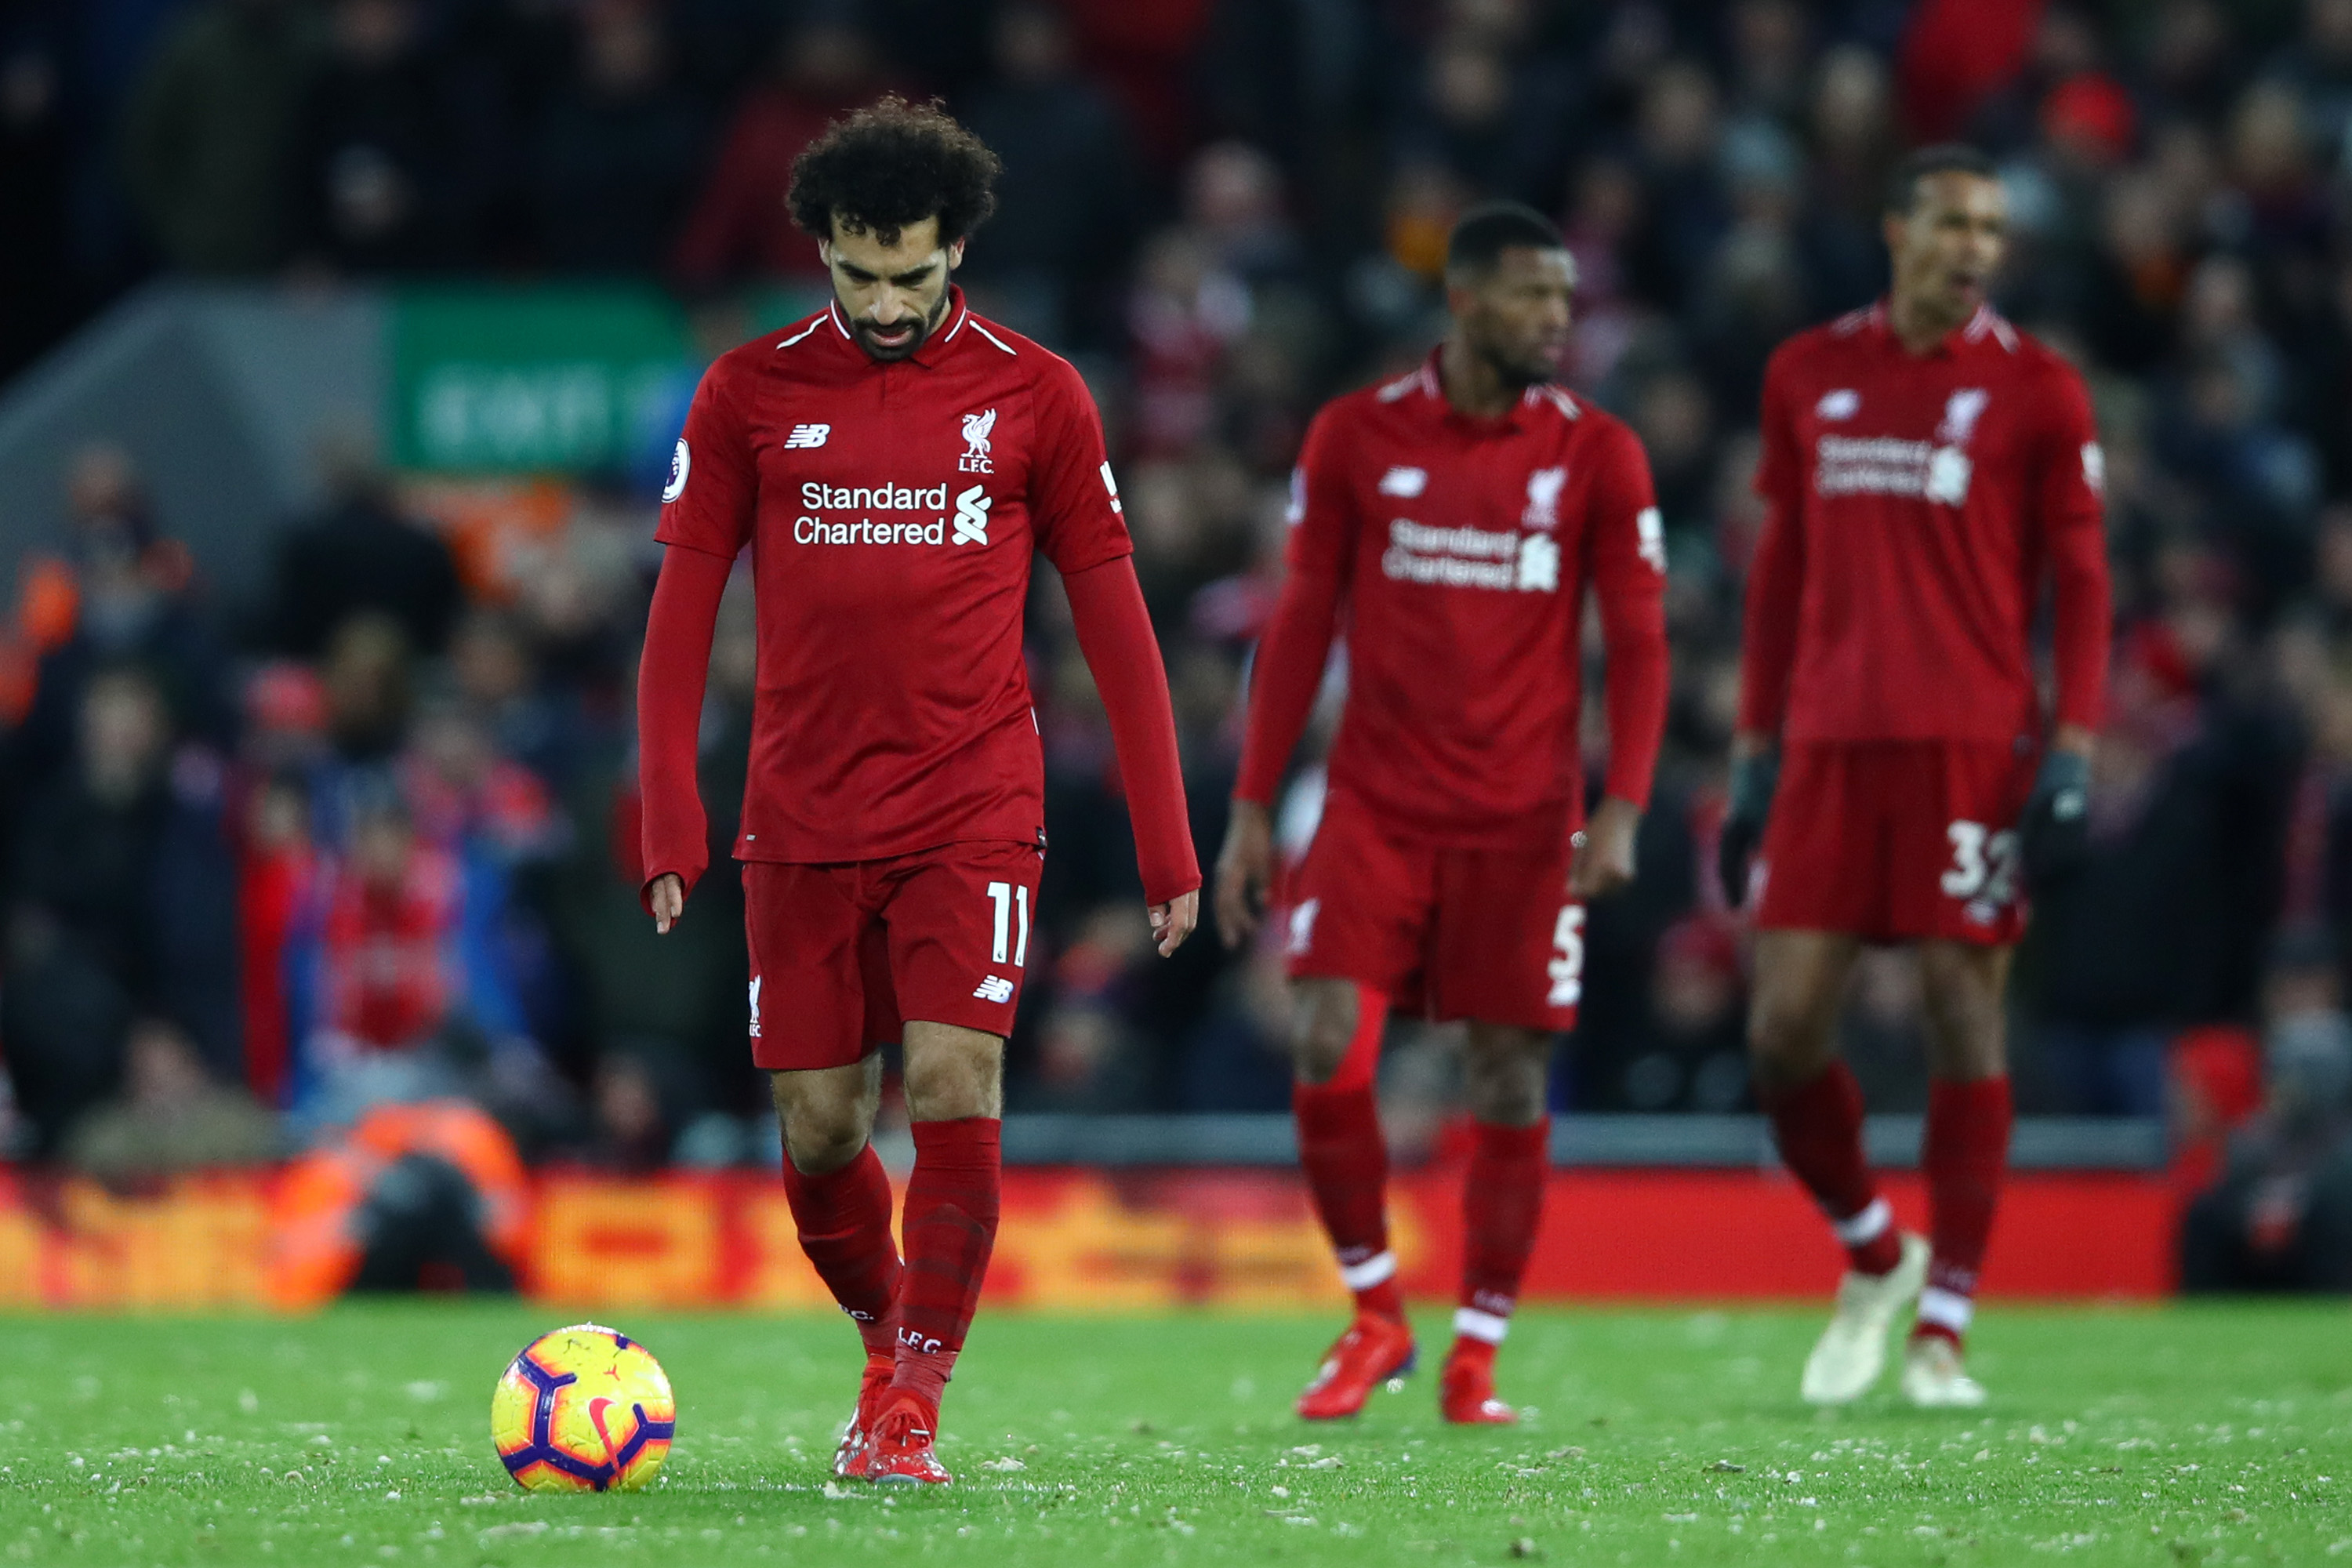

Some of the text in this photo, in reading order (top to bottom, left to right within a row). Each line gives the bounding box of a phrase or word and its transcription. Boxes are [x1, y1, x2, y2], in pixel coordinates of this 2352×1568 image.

[793, 516, 945, 546] Chartered
[801, 481, 948, 510] Standard
[1939, 819, 2023, 904] 32
[986, 880, 1029, 968] 11
[1547, 902, 1589, 981] 5
